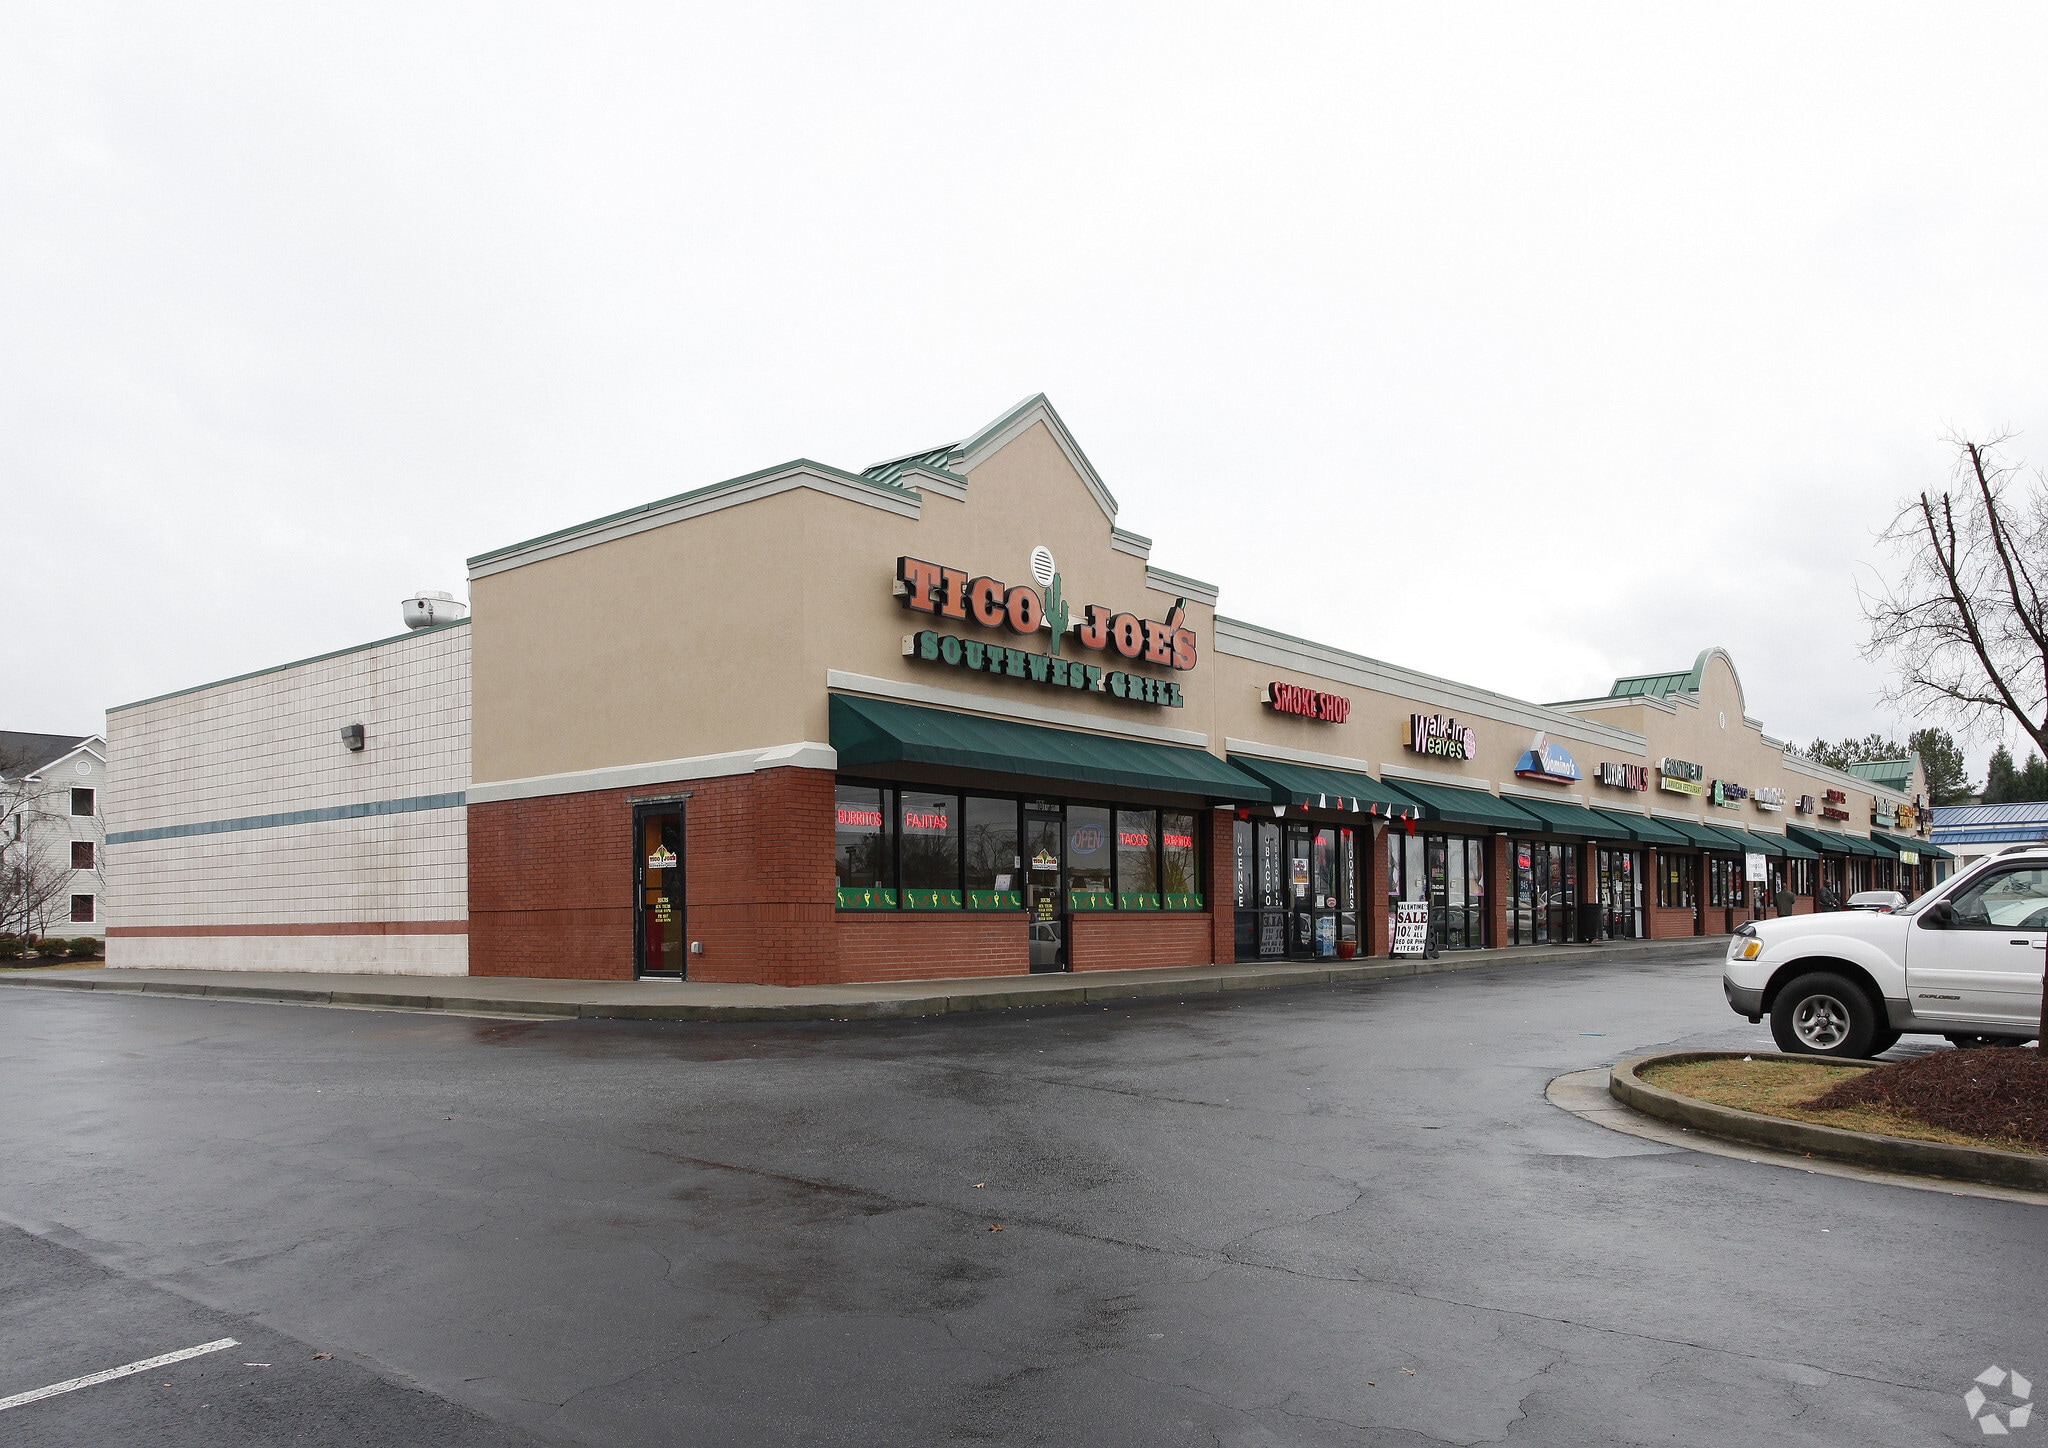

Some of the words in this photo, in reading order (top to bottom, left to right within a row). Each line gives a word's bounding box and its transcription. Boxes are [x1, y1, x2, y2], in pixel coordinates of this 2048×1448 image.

[897, 556, 1044, 635] TICO
[1074, 597, 1197, 671] JOE'S
[914, 630, 1102, 692] SOUTHWEST
[1104, 671, 1184, 708] GRILL
[1270, 681, 1317, 718] SMOKE
[1318, 692, 1351, 724] SHOP
[1603, 762, 1626, 787] LUXURY
[1625, 764, 1649, 792] NAILS
[837, 808, 883, 827] BURRITOS
[906, 812, 948, 829] FAJITAS
[1074, 830, 1101, 849] OPEN
[1119, 832, 1149, 846] TACOS
[1163, 833, 1191, 847] BURRITOS
[1398, 912, 1427, 924] SALE
[1397, 925, 1412, 938] 10%
